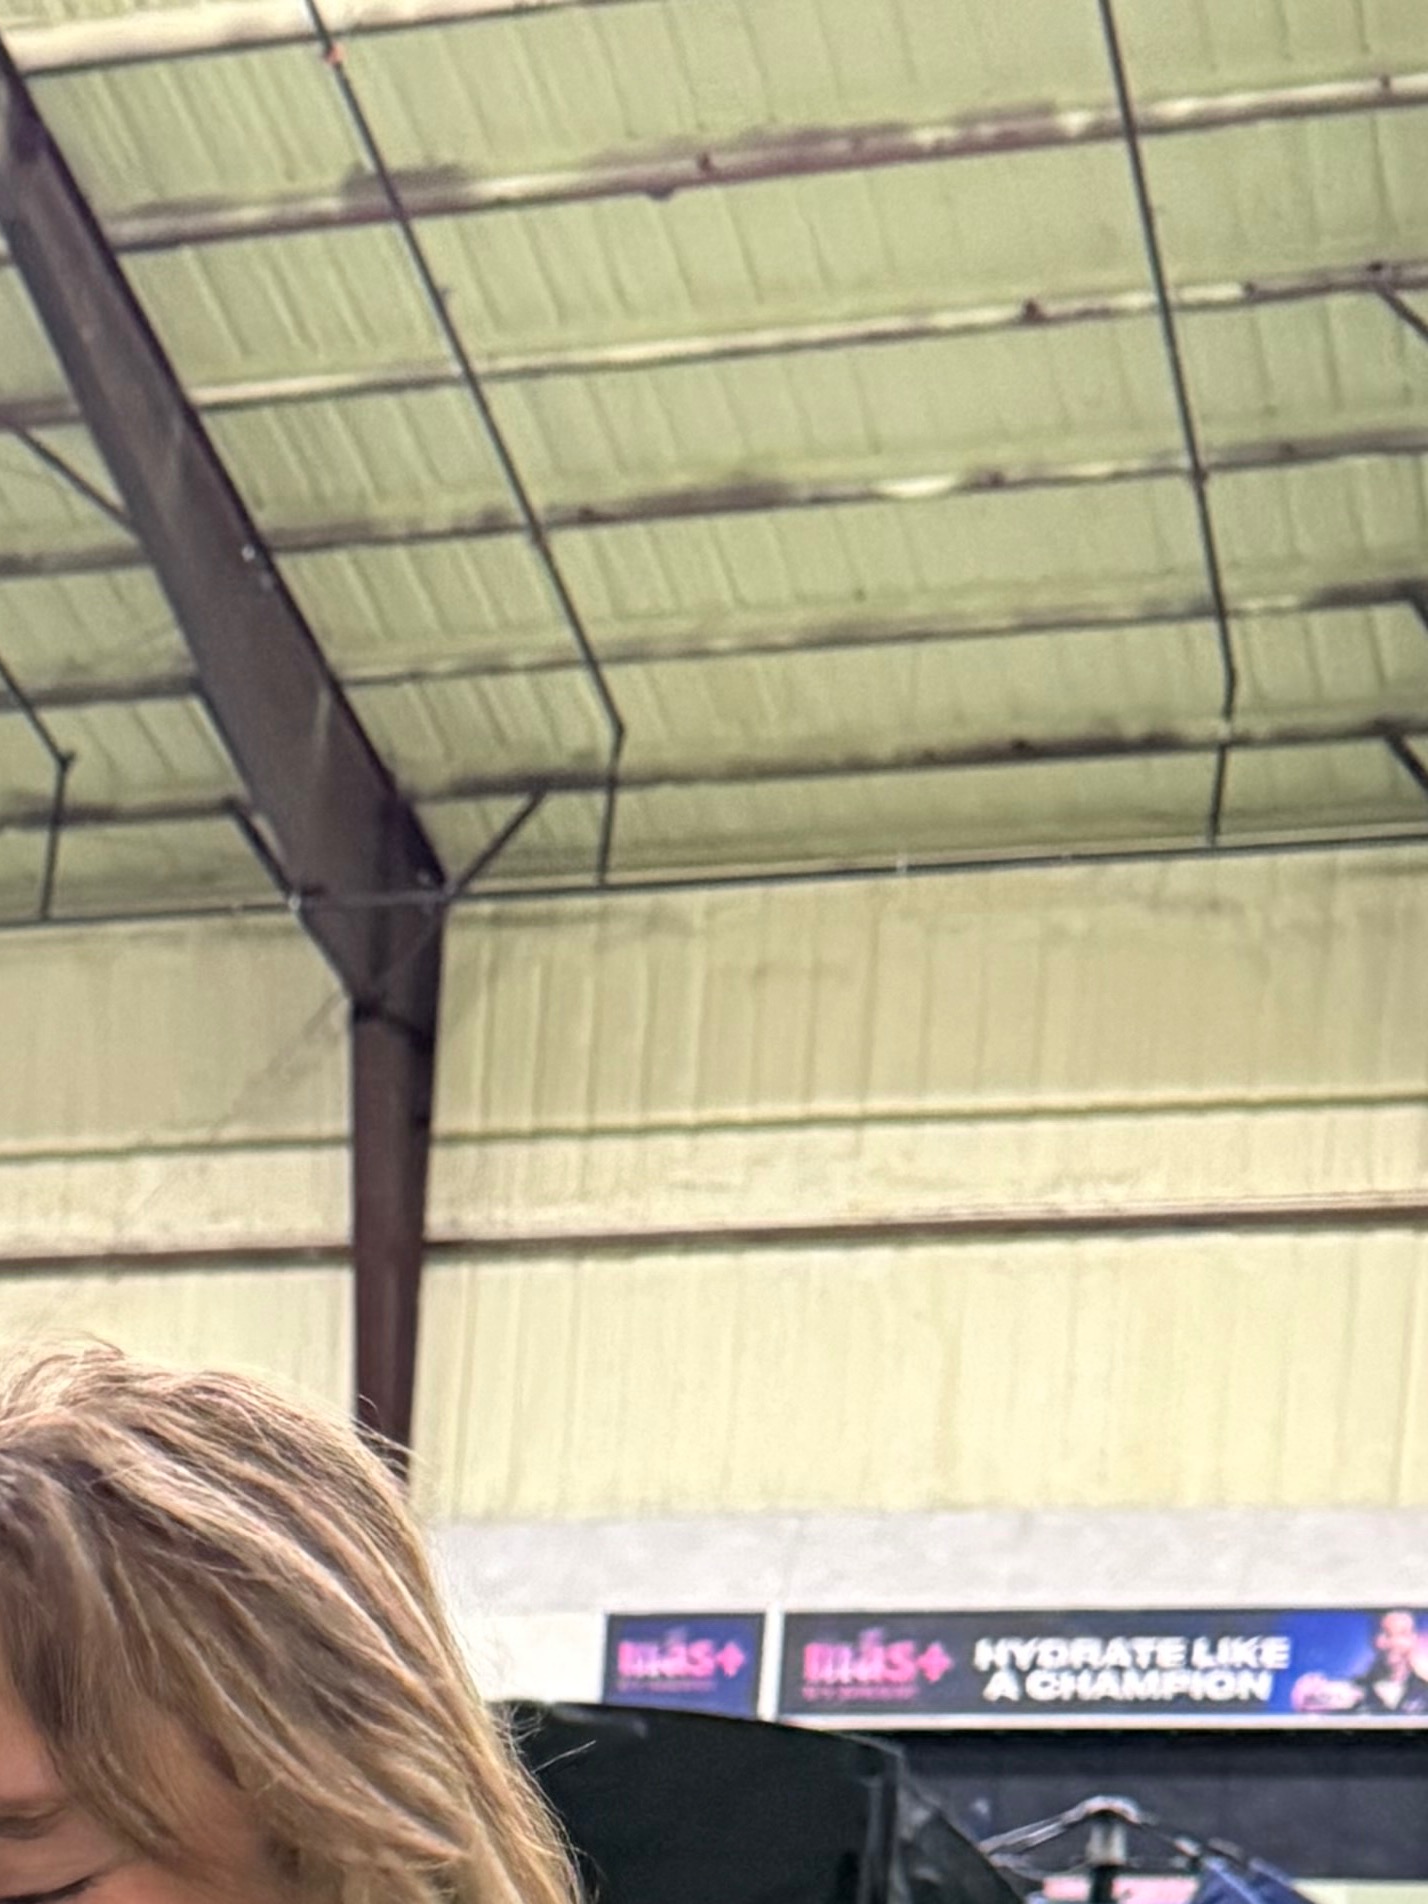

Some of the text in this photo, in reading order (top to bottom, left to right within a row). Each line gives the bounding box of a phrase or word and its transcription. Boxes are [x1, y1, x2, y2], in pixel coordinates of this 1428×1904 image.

[974, 1636, 1291, 1670] HYDRATE LIKE
[982, 1668, 1021, 1701] A
[1025, 1668, 1273, 1701] CHAMPION
